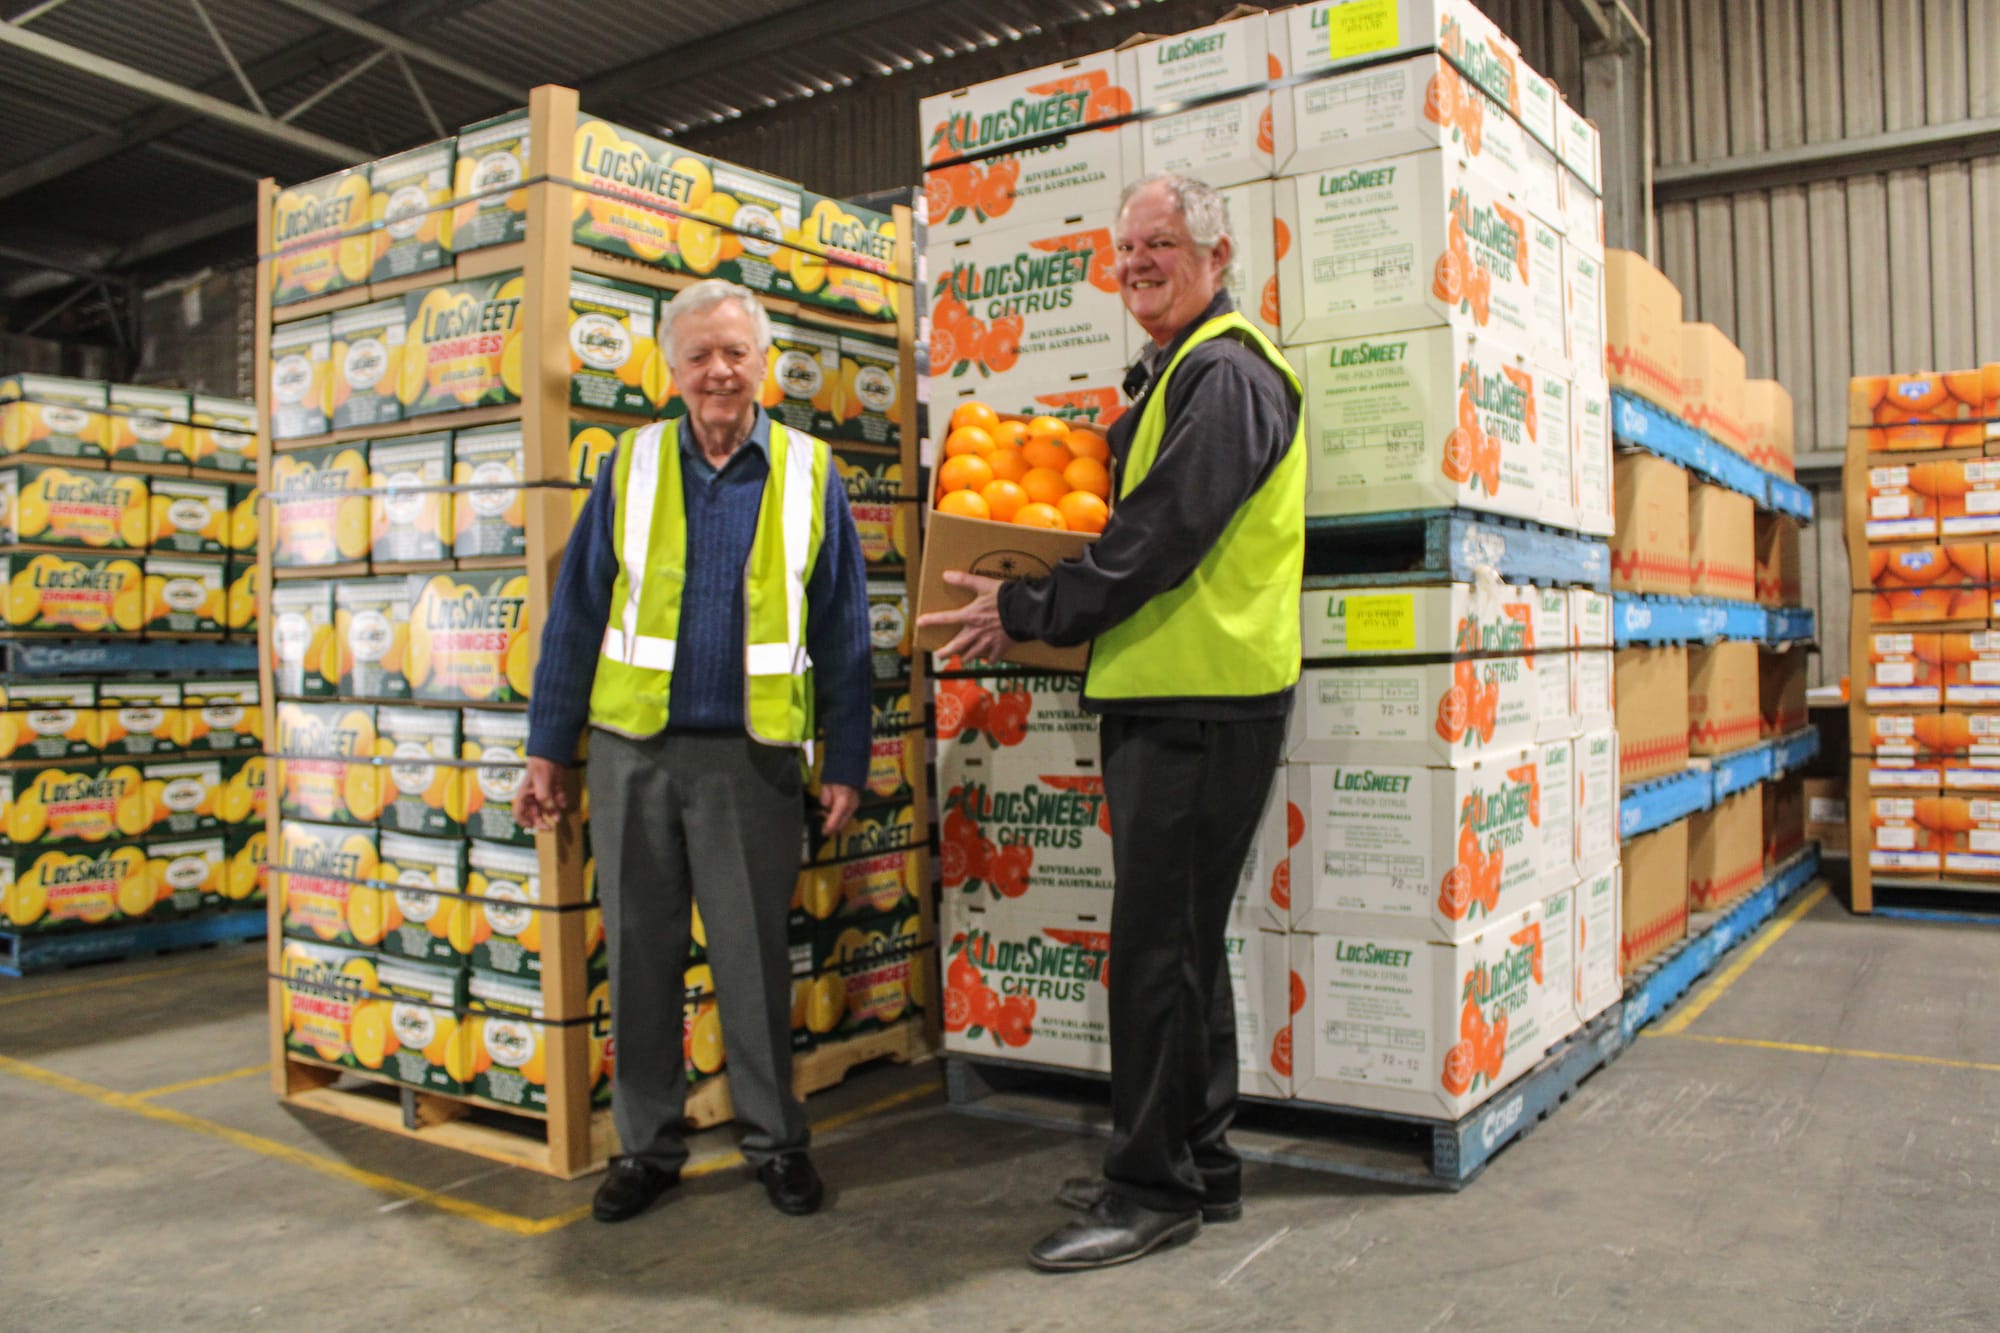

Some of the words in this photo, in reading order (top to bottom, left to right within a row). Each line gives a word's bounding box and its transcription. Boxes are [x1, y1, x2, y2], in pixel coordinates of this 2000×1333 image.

[581, 133, 696, 204] LOCSWEET
[987, 286, 1074, 321] CITRUS
[1333, 768, 1412, 794] LOCSWEET
[997, 826, 1083, 849] CITRUS
[1335, 939, 1413, 968] LOCSWEET
[1000, 974, 1087, 1002] CITRUS
